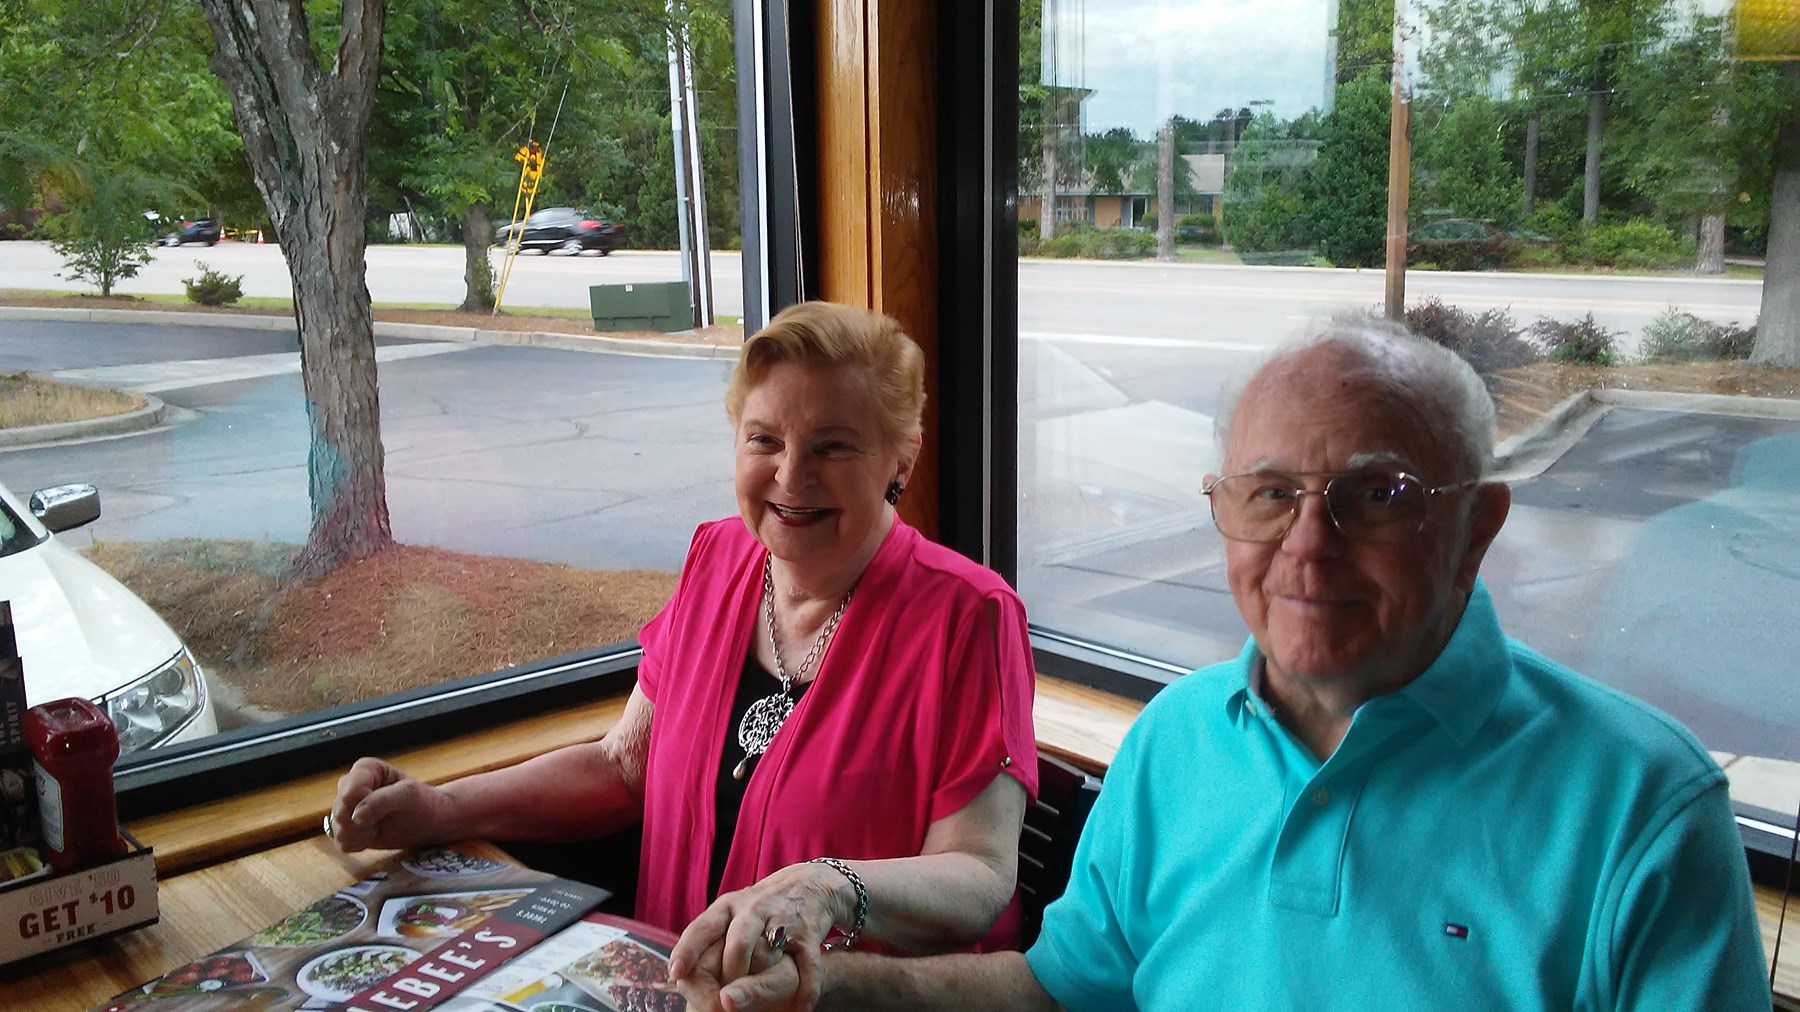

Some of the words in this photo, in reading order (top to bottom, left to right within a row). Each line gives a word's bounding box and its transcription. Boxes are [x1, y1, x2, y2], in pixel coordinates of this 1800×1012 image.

[6, 701, 21, 744] SPIRIT
[18, 900, 80, 940] GET
[88, 884, 136, 916] $10
[56, 923, 96, 944] FREE
[346, 931, 517, 1012] EBEE'S
